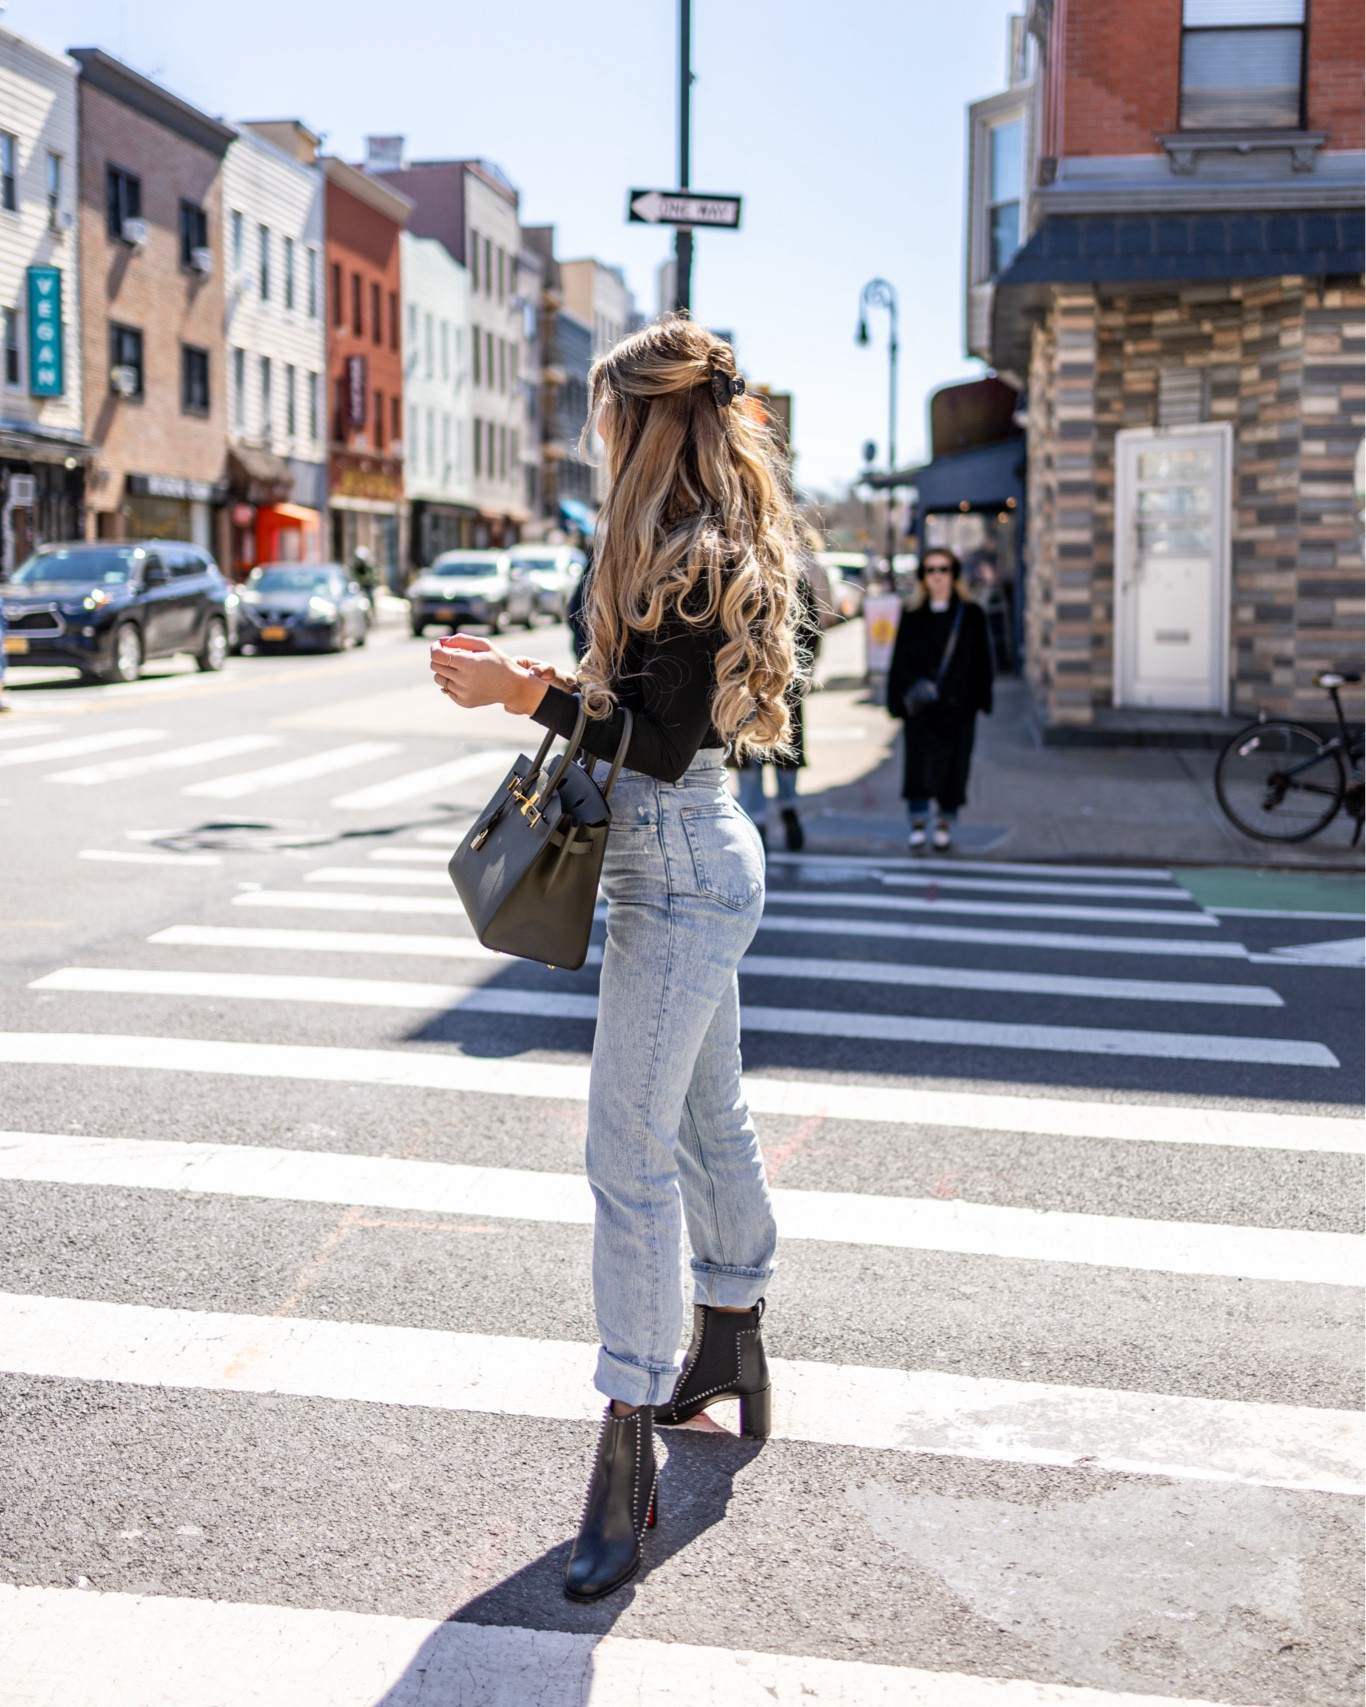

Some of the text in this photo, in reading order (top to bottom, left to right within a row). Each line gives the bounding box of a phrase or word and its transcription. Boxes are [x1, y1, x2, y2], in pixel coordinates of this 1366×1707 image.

[659, 200, 728, 218] ONE WAY
[36, 277, 56, 386] VEGAN
